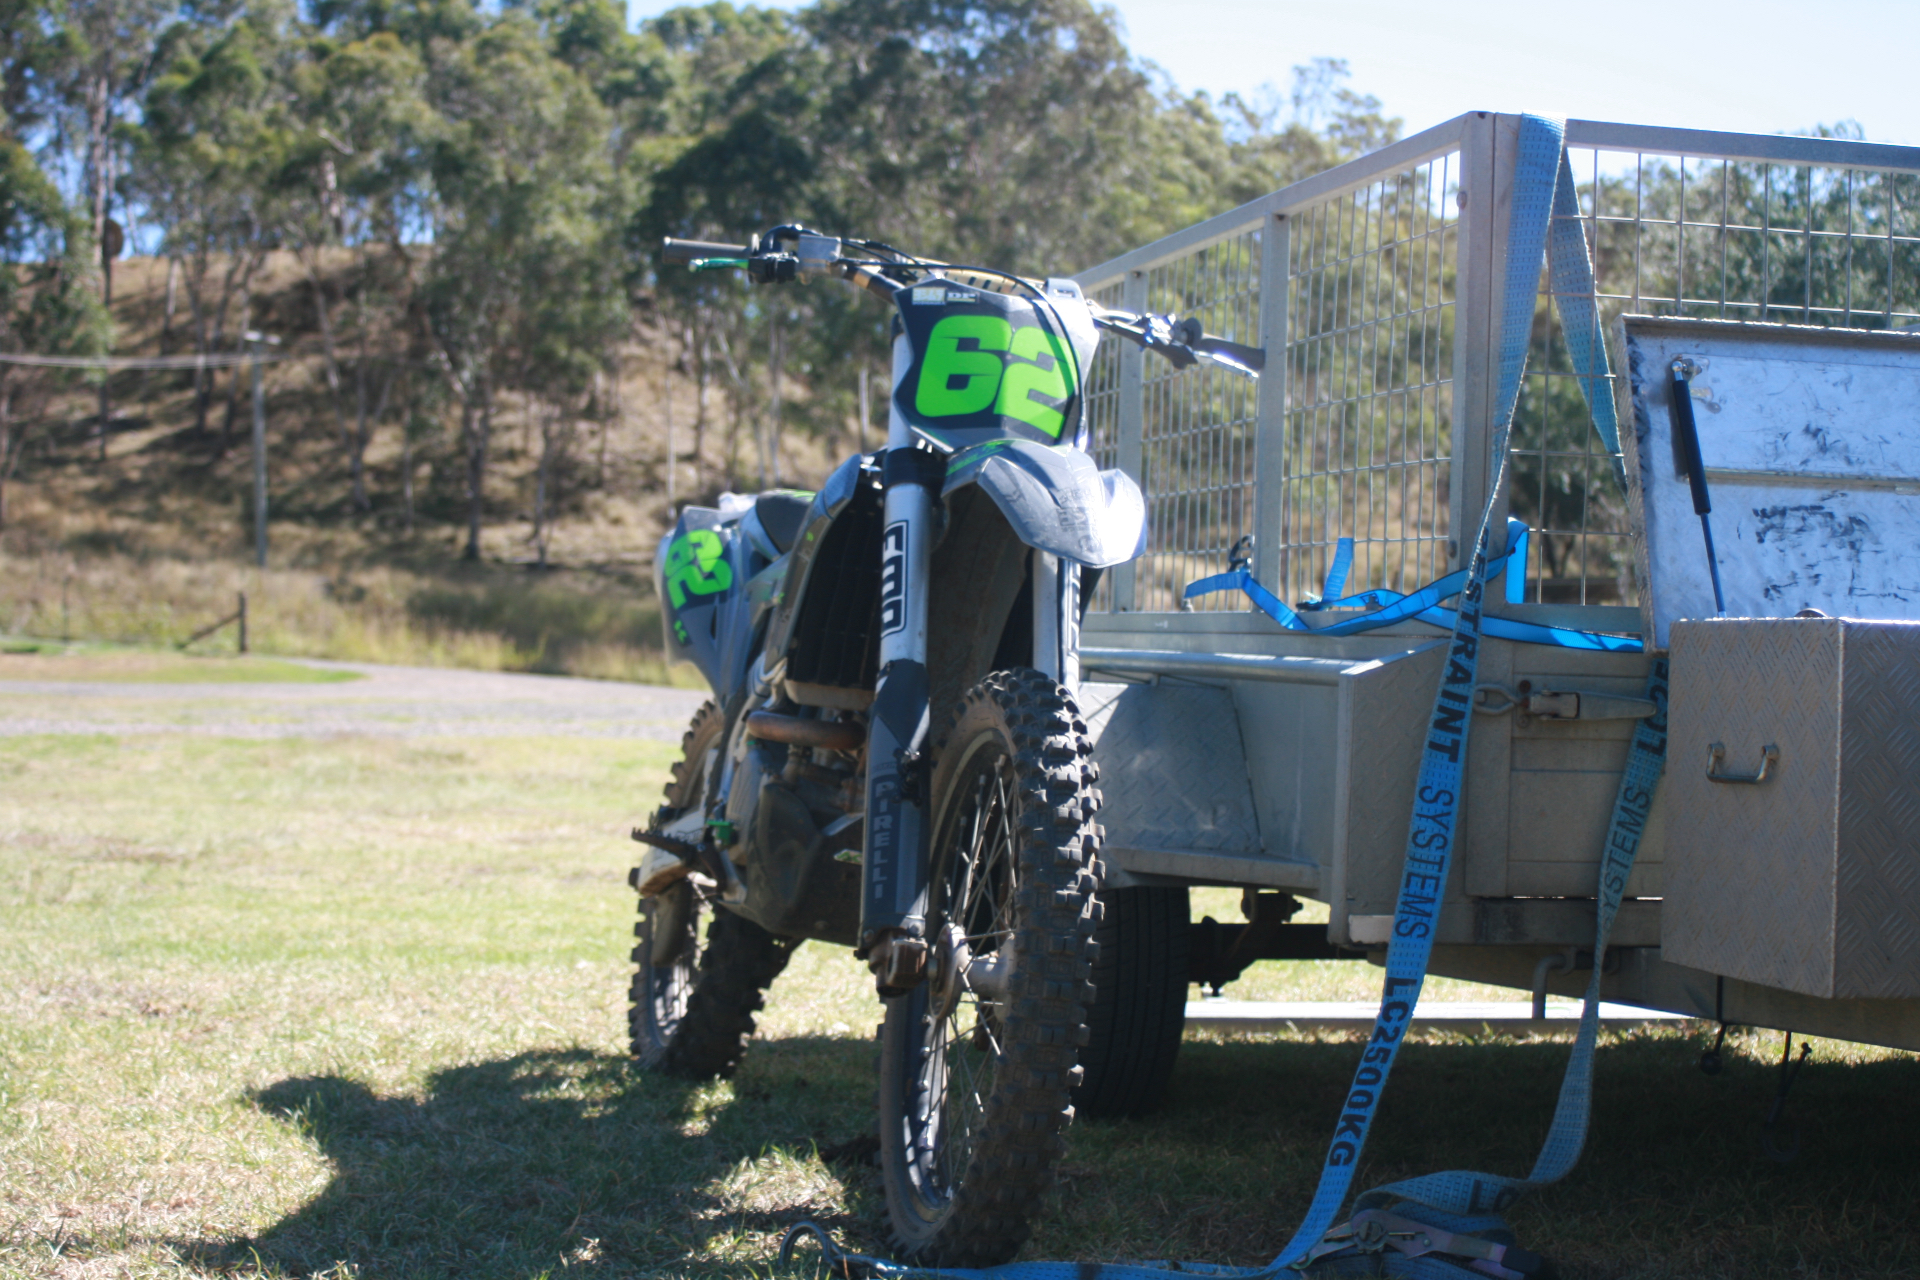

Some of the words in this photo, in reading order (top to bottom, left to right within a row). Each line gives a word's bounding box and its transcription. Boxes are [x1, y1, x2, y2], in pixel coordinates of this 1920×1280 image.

[915, 315, 1081, 438] 62
[665, 530, 732, 609] 62
[872, 781, 895, 898] PIRELLI
[1395, 785, 1454, 938] SYSTEMS
[1329, 977, 1417, 1167] LC2500KG
